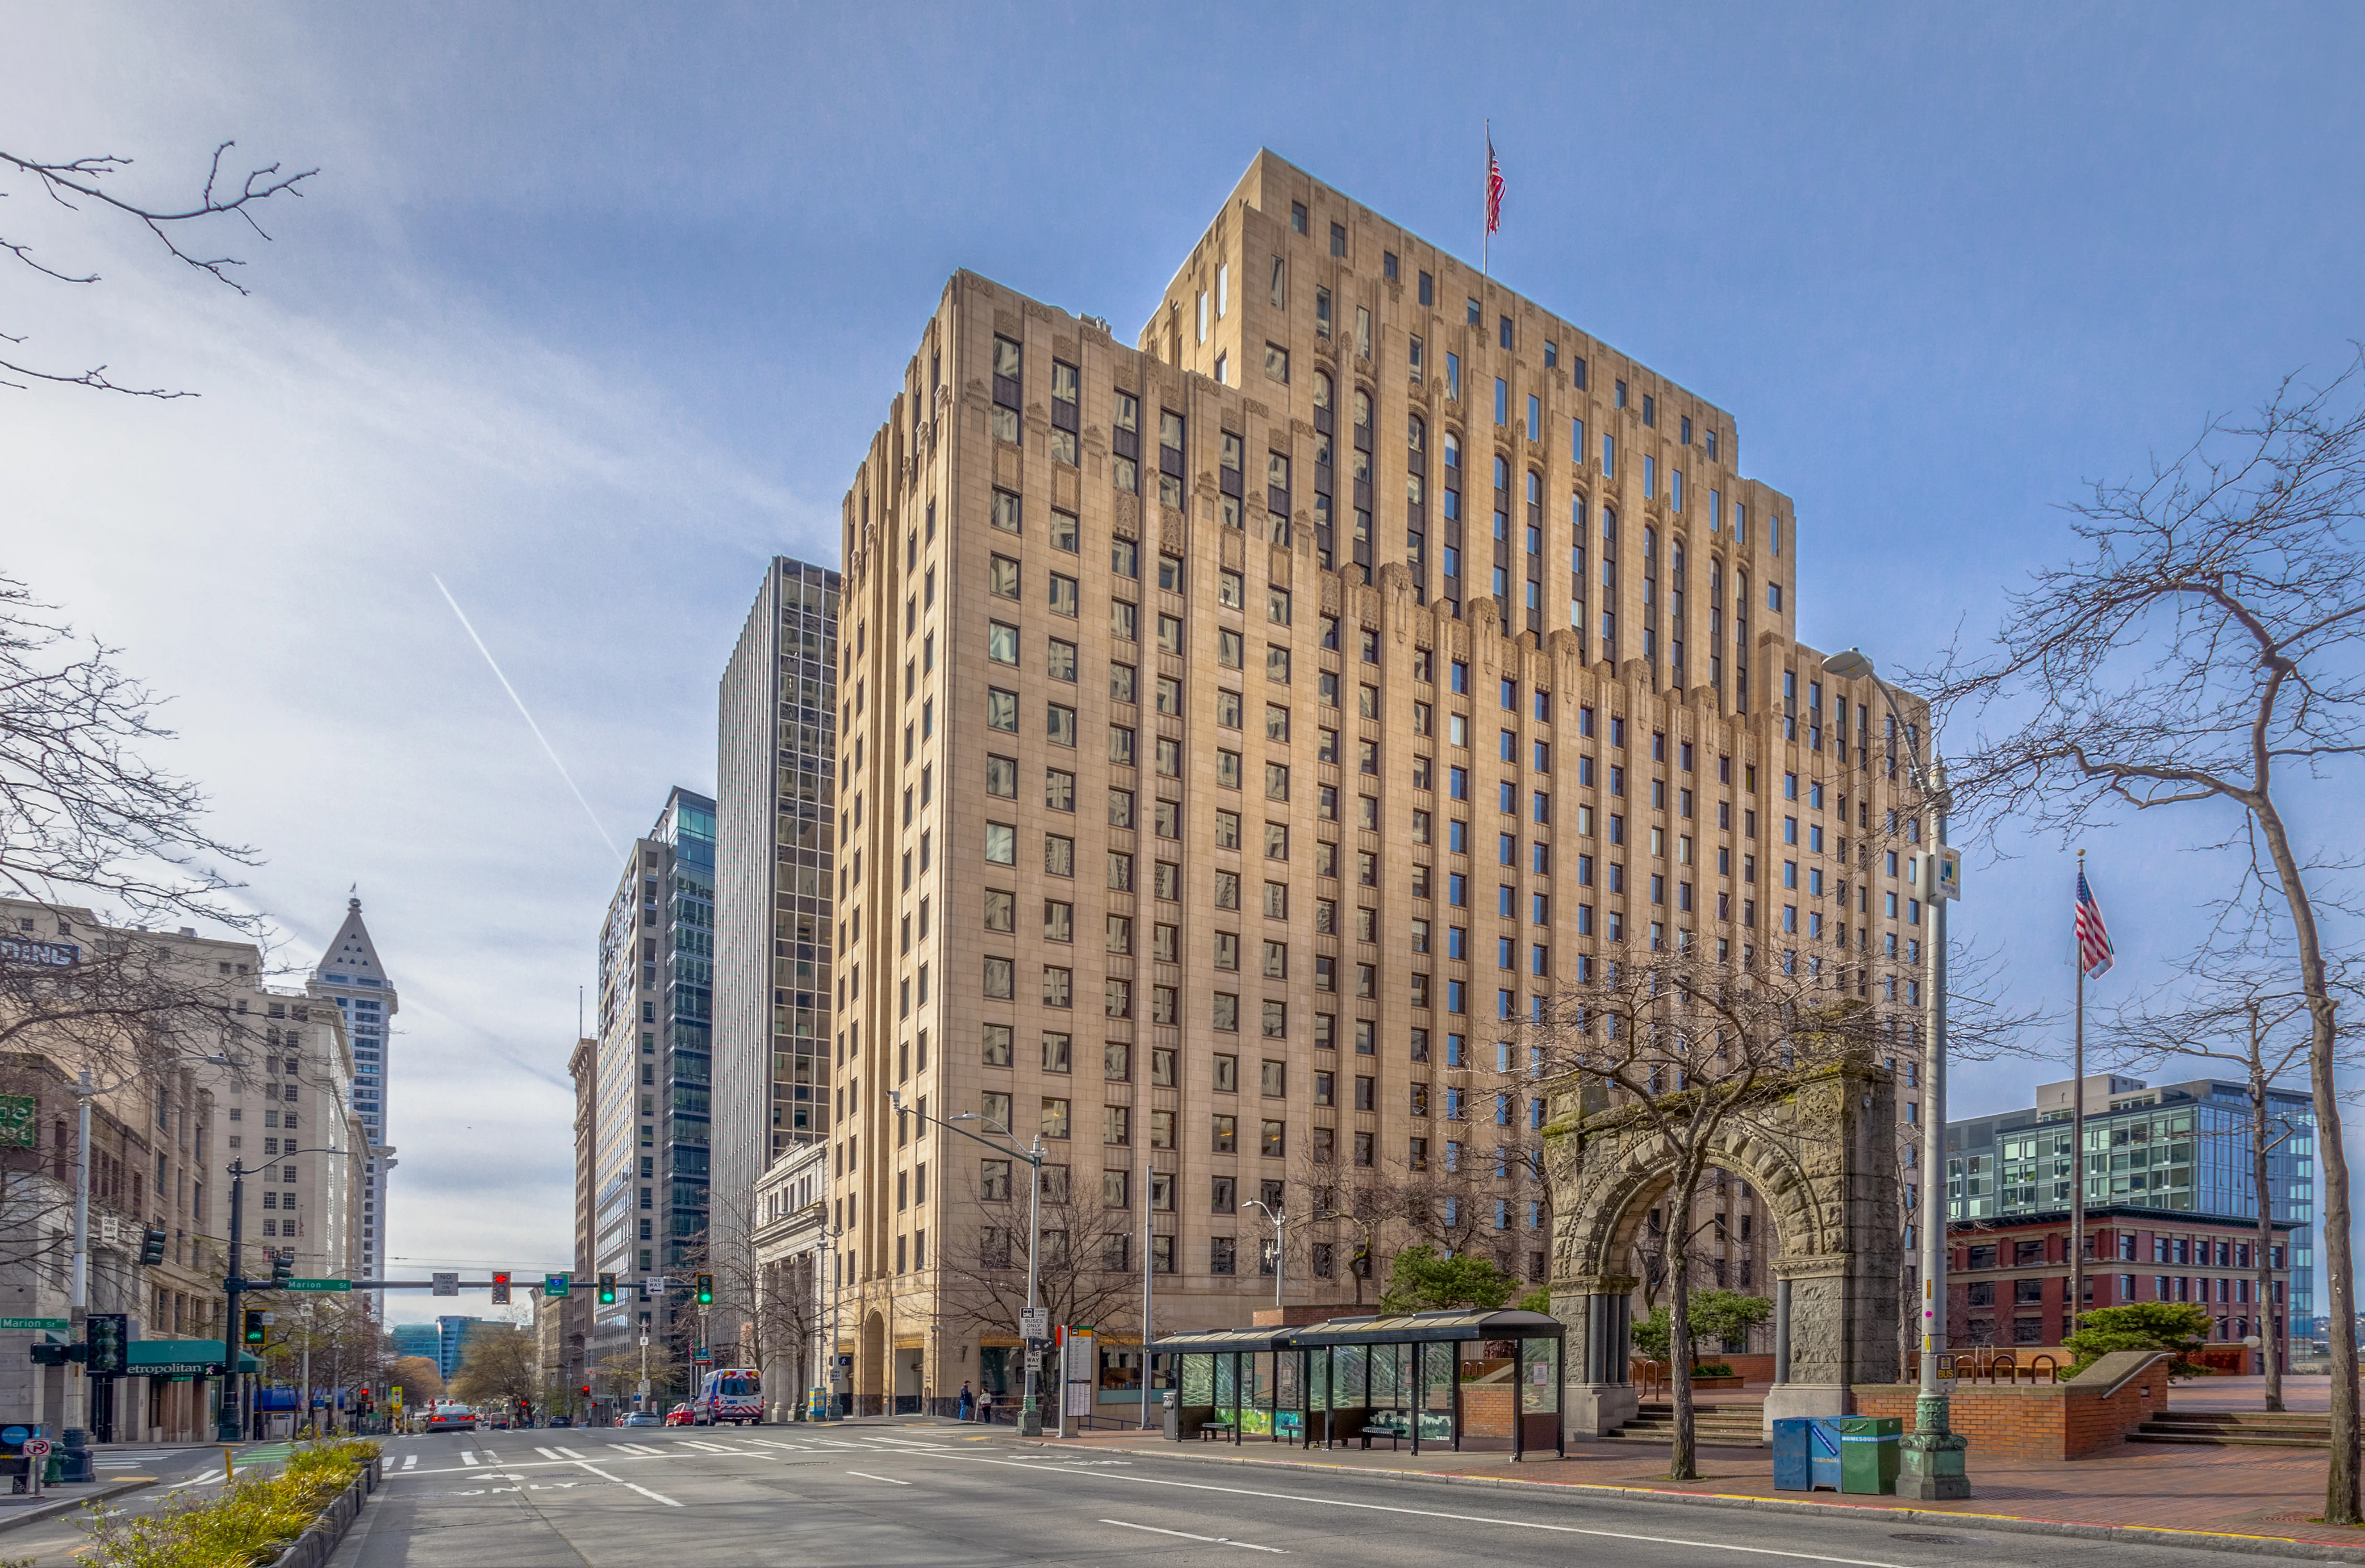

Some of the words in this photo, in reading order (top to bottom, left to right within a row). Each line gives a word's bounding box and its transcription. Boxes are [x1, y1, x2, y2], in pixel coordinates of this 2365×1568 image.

[3, 1319, 41, 1327] Marion
[127, 1363, 201, 1374] etropolitan
[1938, 1369, 1954, 1378] BUS
[461, 1482, 578, 1496] ONLY
